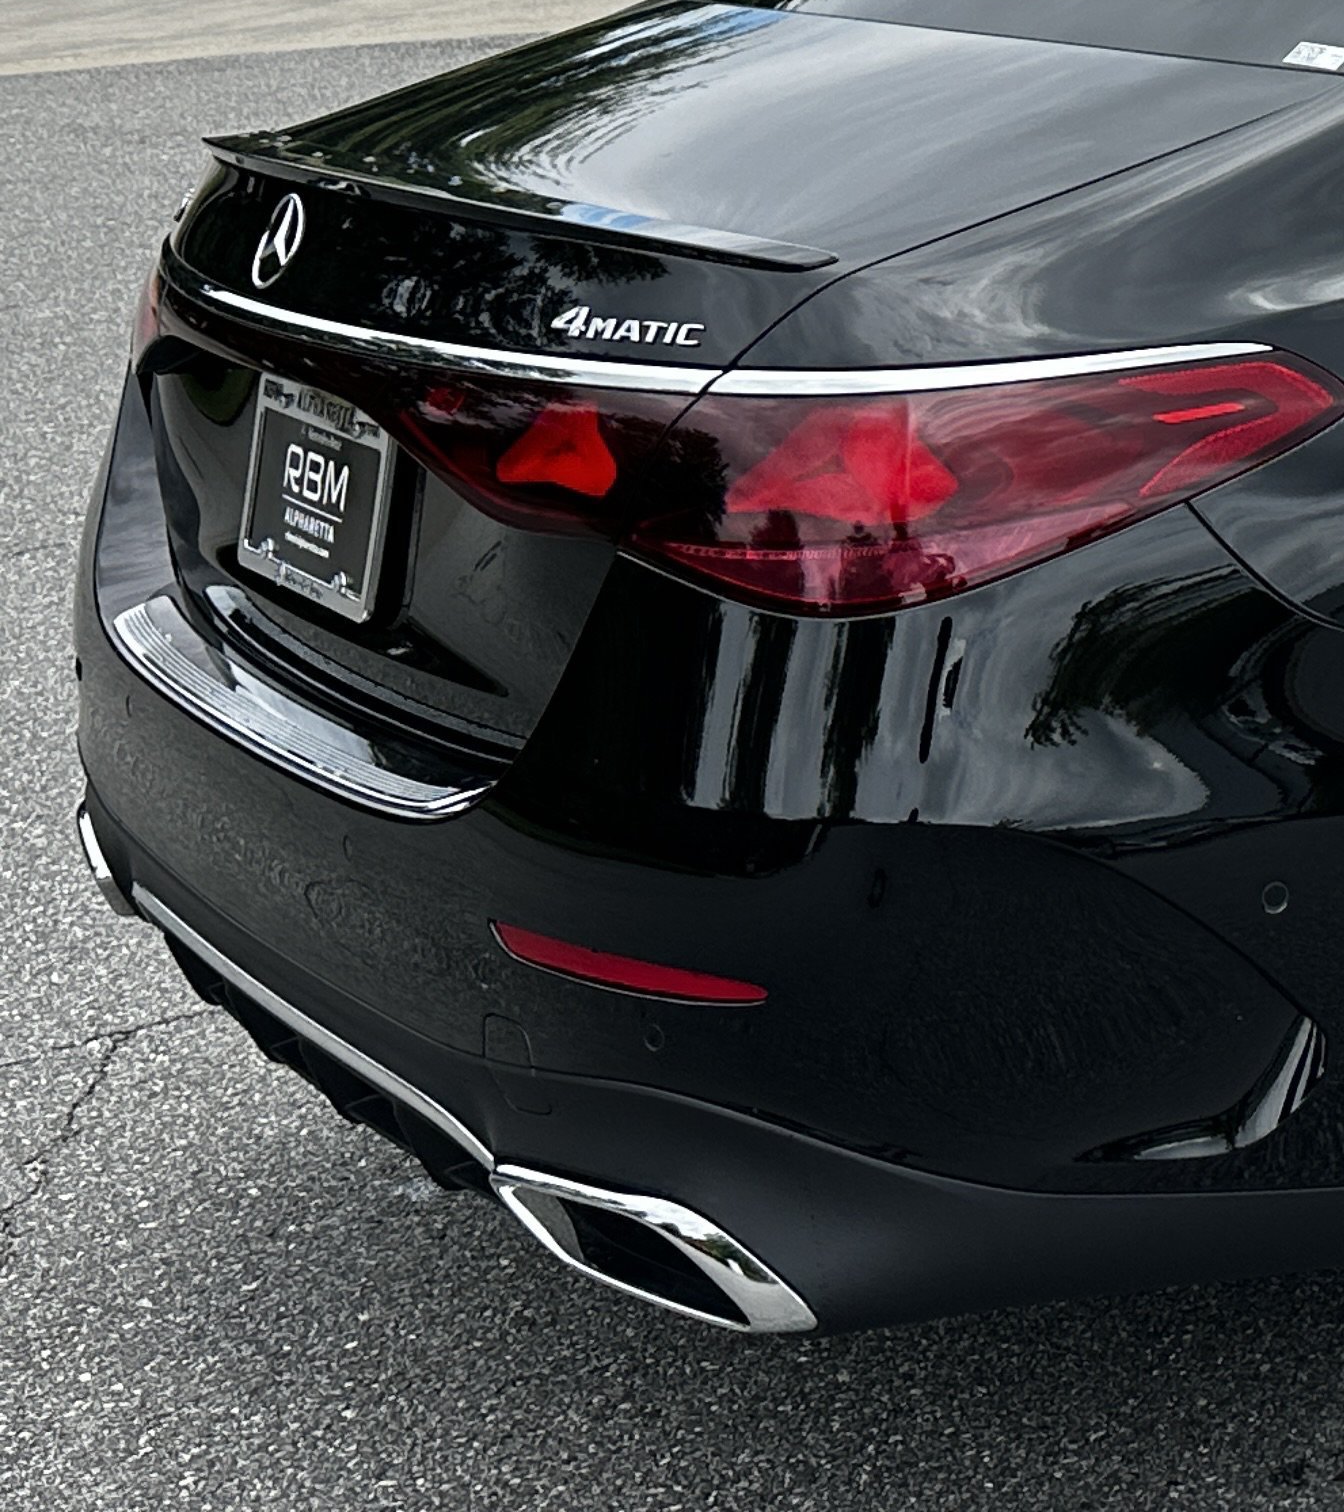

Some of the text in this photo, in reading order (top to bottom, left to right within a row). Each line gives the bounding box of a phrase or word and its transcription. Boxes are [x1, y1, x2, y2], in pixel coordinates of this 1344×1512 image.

[550, 305, 705, 347] 4MATIC
[282, 443, 350, 513] RBM
[283, 505, 335, 544] ALPHARETTA
